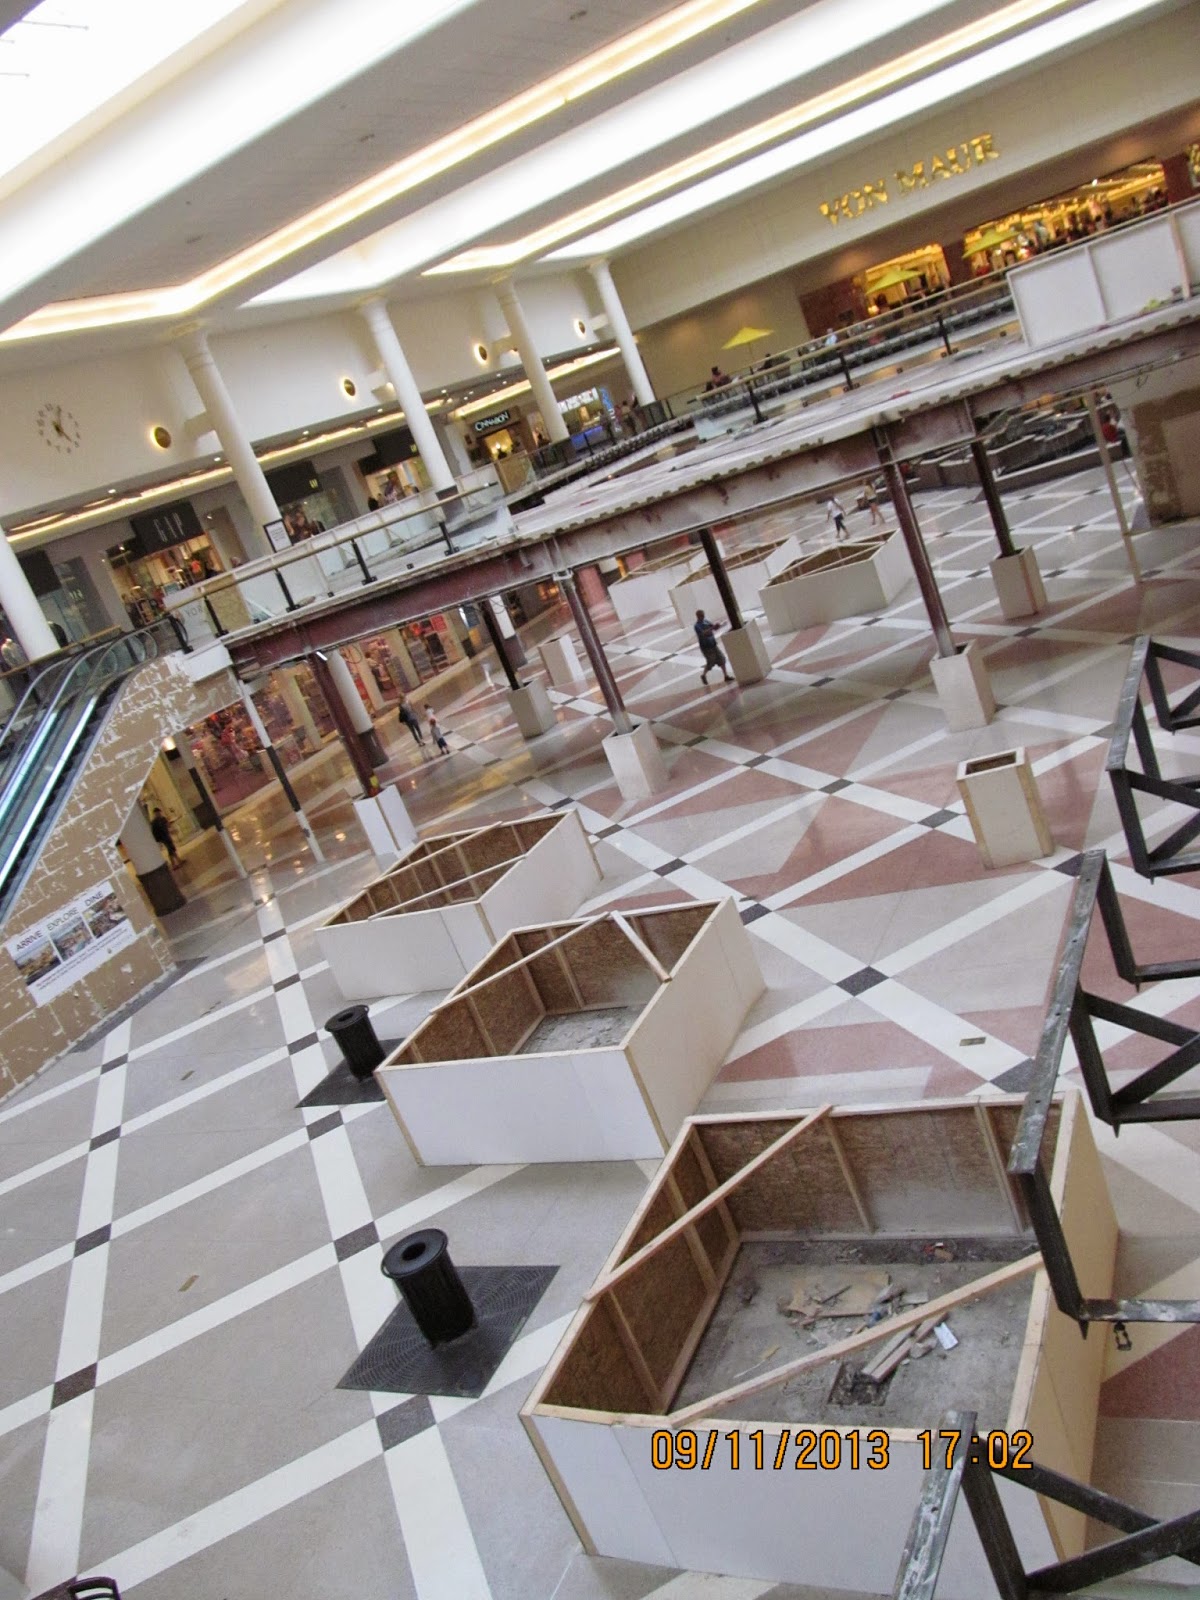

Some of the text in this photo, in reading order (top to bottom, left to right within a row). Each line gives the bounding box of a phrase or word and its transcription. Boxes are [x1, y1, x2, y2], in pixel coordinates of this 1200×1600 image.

[819, 132, 999, 226] VON MAUR
[153, 512, 186, 543] GAP
[16, 891, 104, 951] ARRIVE EXPLORE DINE
